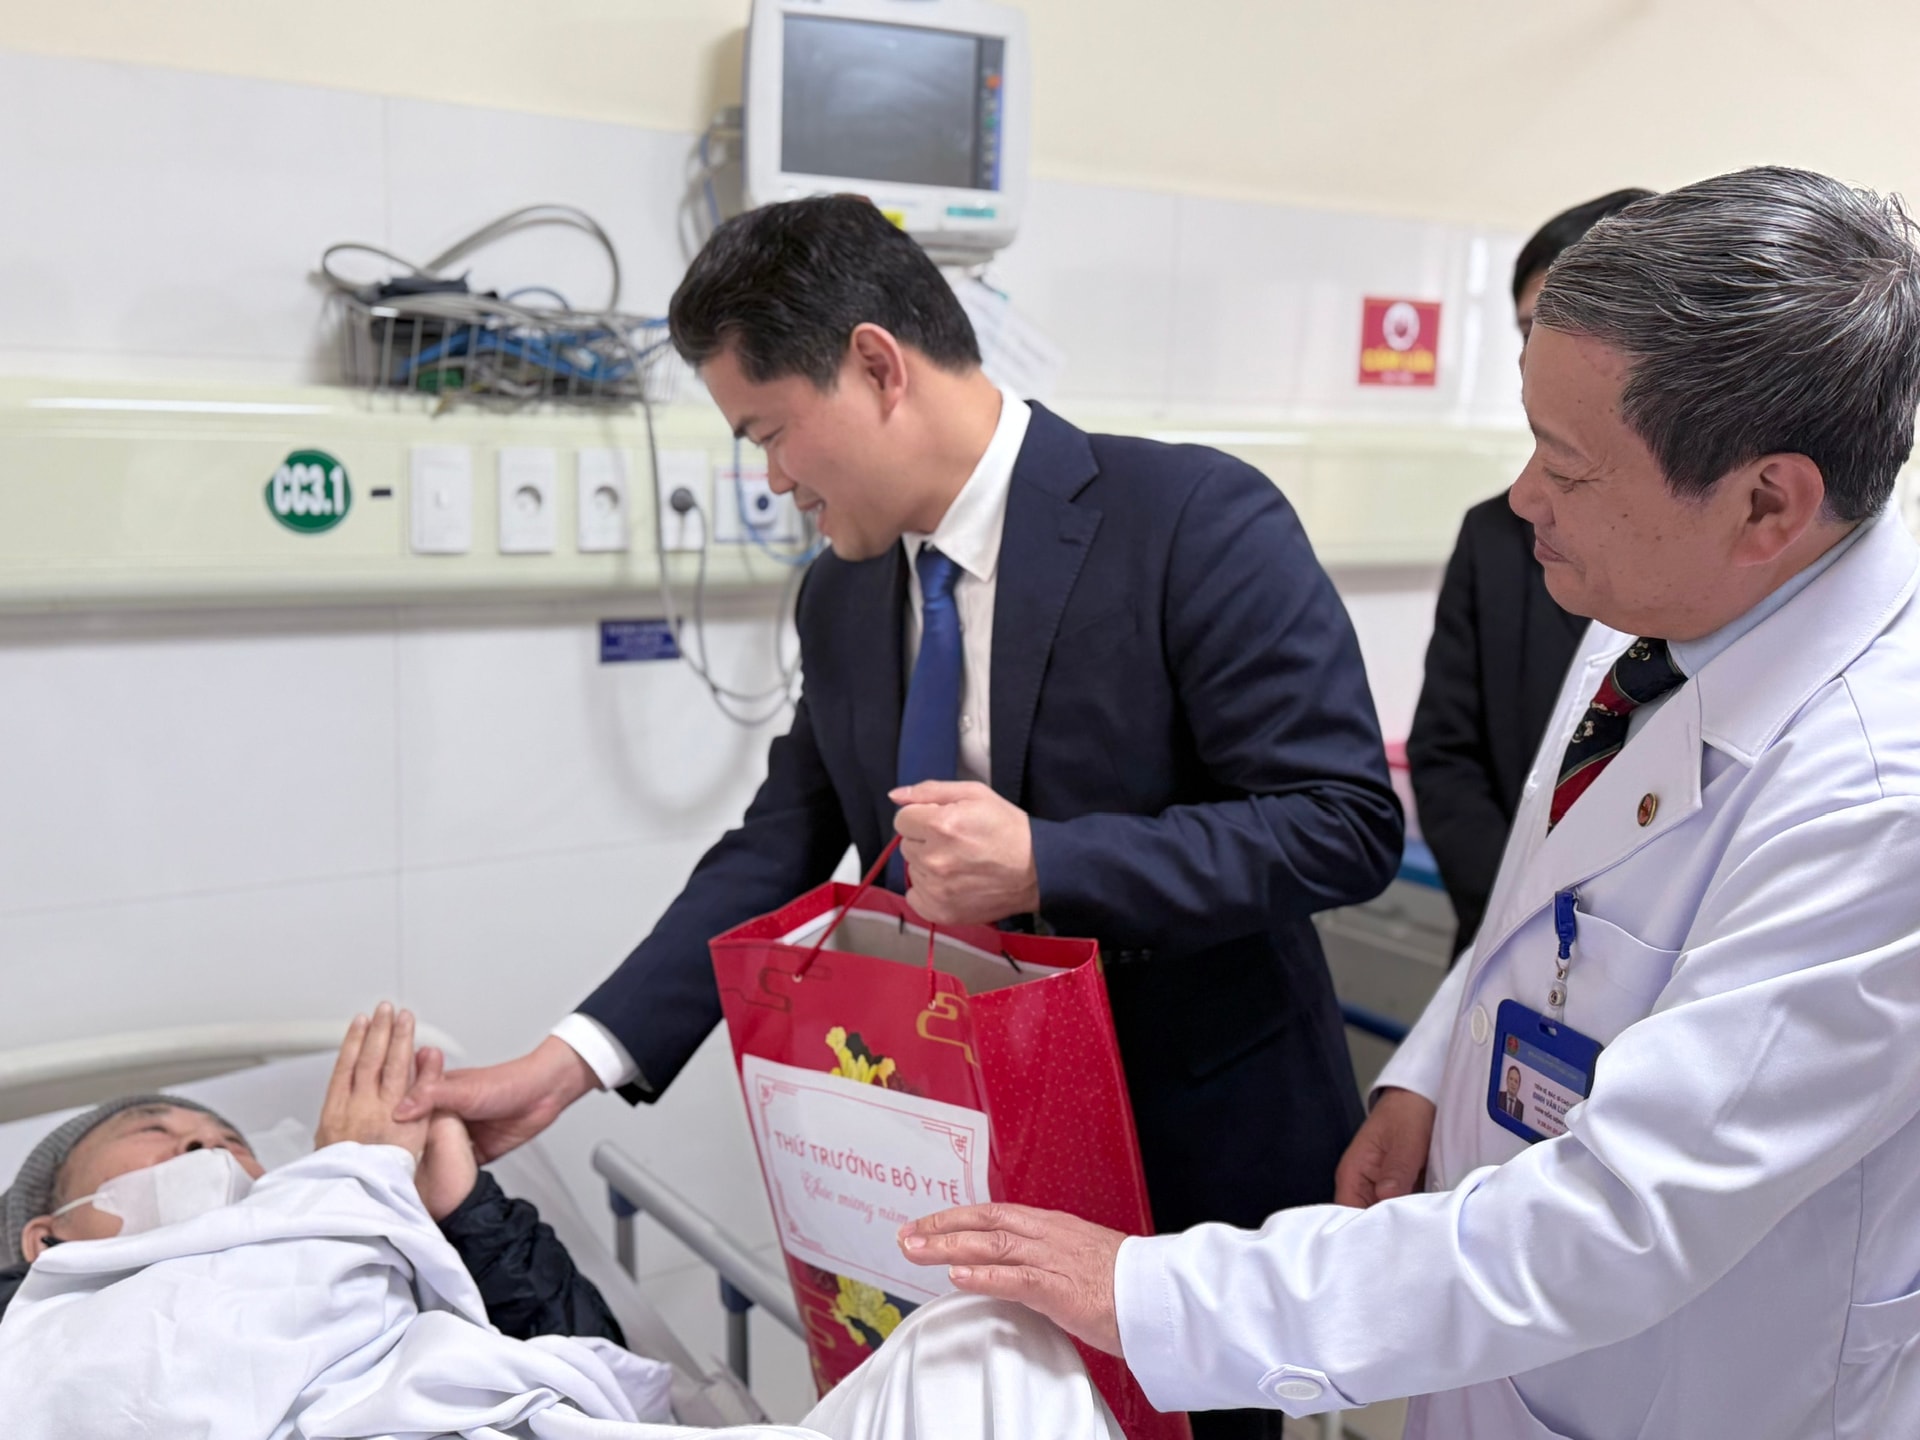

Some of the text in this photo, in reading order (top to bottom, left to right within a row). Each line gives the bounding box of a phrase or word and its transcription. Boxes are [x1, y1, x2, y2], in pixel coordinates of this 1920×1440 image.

[272, 462, 345, 516] CC3.1
[774, 1130, 961, 1206] THỨ TRƯỞNG BỘ Y TẾ
